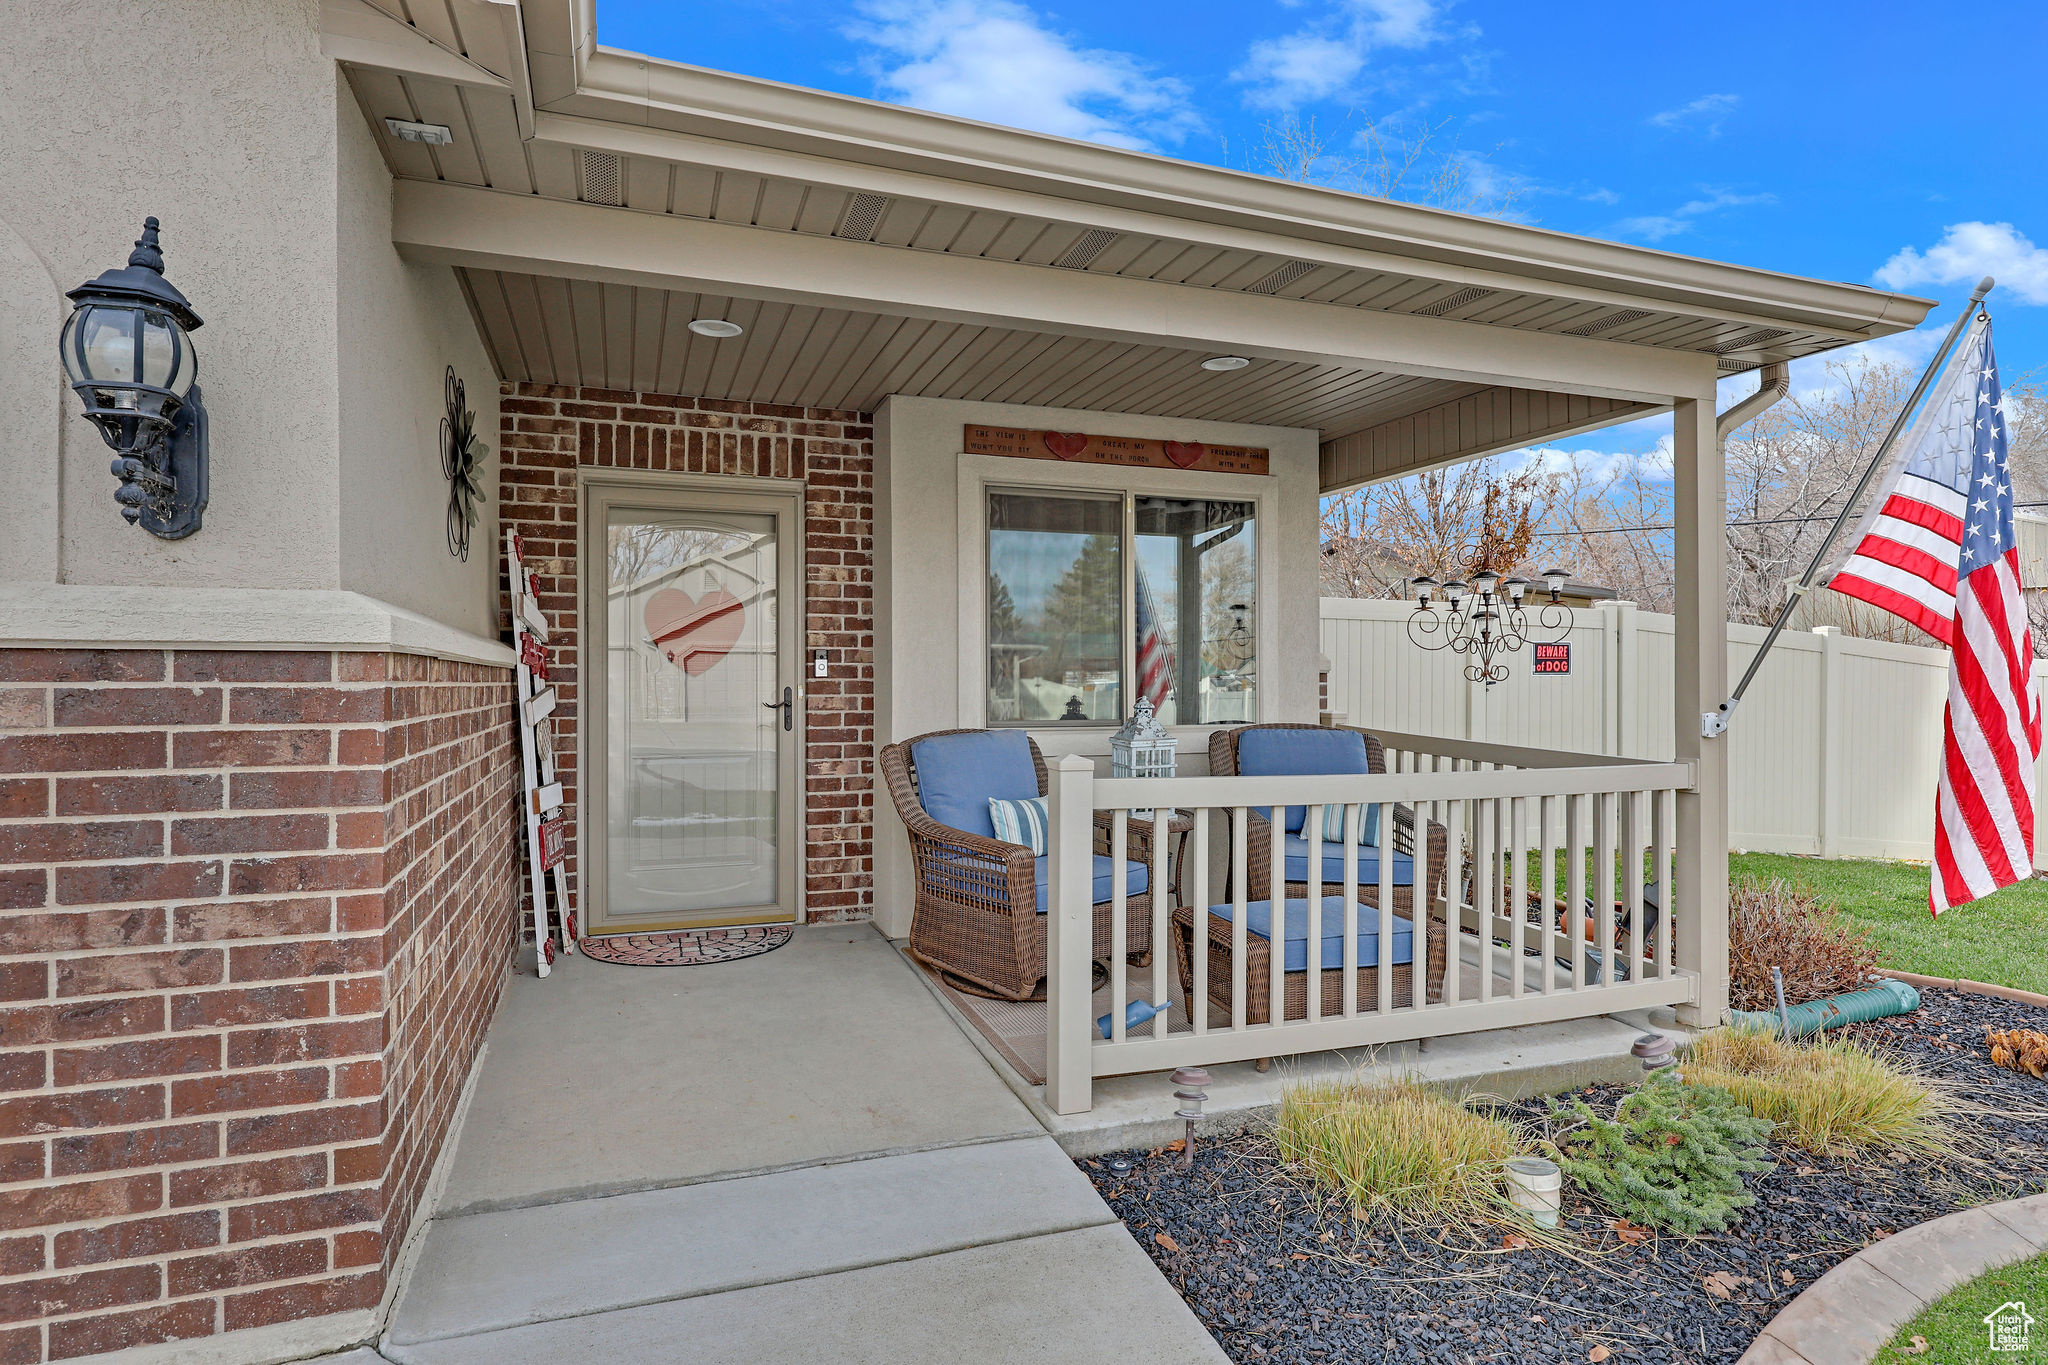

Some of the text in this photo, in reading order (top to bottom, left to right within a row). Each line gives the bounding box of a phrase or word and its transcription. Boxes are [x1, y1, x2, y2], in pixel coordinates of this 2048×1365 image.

[1134, 442, 1144, 450] MY
[970, 442, 993, 450] WON'T
[1219, 460, 1233, 468] WITH
[1537, 646, 1568, 657] BEWARE
[1536, 661, 1568, 671] of DOG
